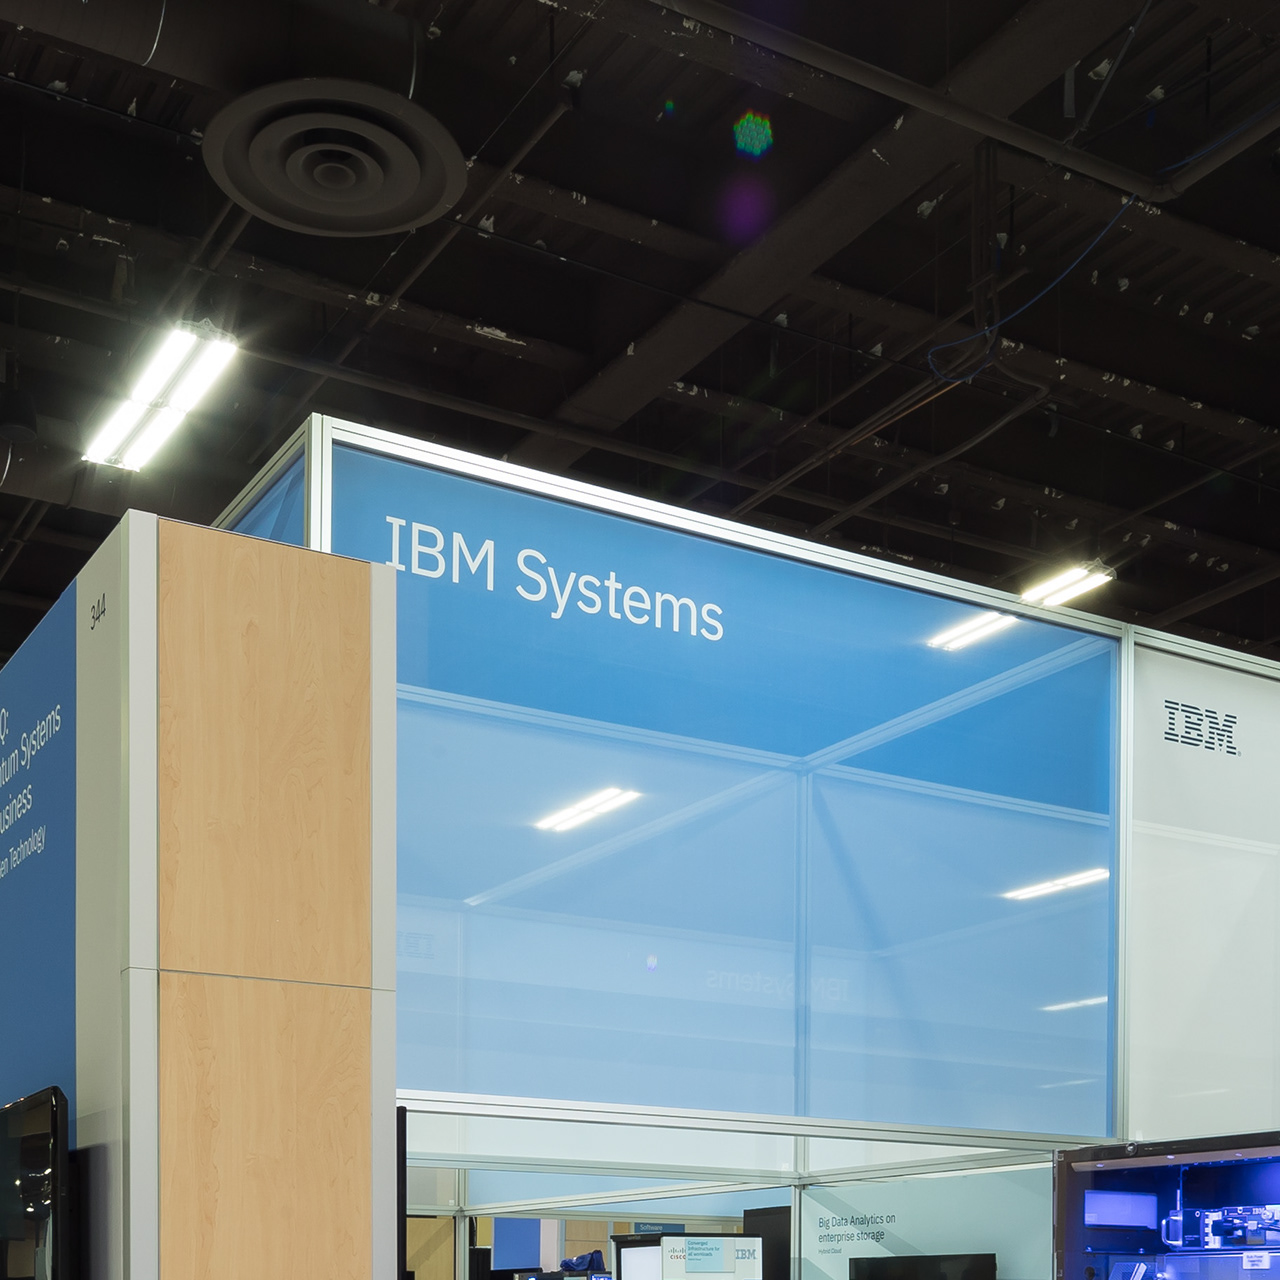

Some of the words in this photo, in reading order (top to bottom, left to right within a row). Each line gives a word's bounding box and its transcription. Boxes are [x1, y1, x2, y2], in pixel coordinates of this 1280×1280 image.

[385, 515, 495, 591] IBM
[515, 548, 724, 641] Systems
[90, 593, 106, 631] 344
[0, 708, 9, 745] Q:
[20, 704, 61, 769] Systems
[1164, 699, 1237, 756] IBM
[8, 824, 46, 870] Technology
[818, 1217, 830, 1230] Big
[832, 1217, 848, 1227] Data
[850, 1213, 884, 1228] Analytics
[886, 1214, 896, 1223] on
[818, 1230, 855, 1244] enterprise
[856, 1230, 885, 1243] storage
[735, 1248, 757, 1260] IBM
